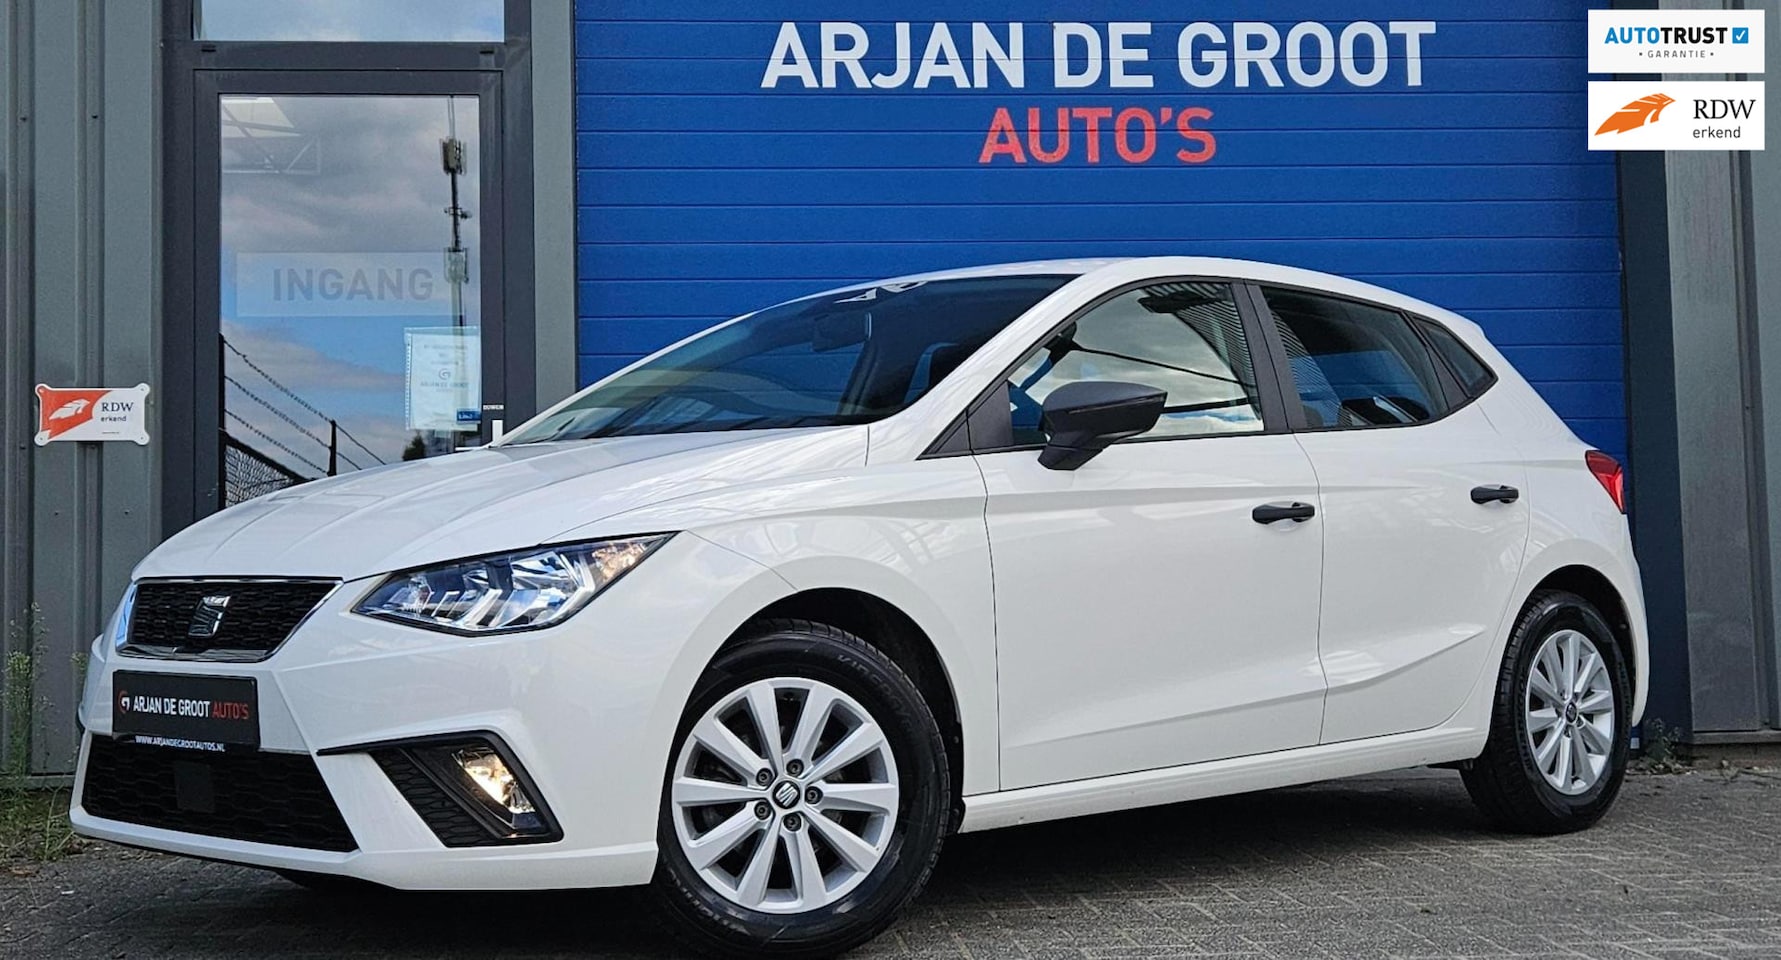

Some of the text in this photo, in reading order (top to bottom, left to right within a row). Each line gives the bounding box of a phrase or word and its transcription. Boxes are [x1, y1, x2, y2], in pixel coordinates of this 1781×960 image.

[760, 21, 1436, 88] ARJAN DE GROOT
[978, 107, 1217, 163] AUTO'S
[272, 268, 434, 301] INGANG
[101, 402, 134, 412] RDW
[133, 695, 249, 719] ARJAN DE GROOT AUTO'S
